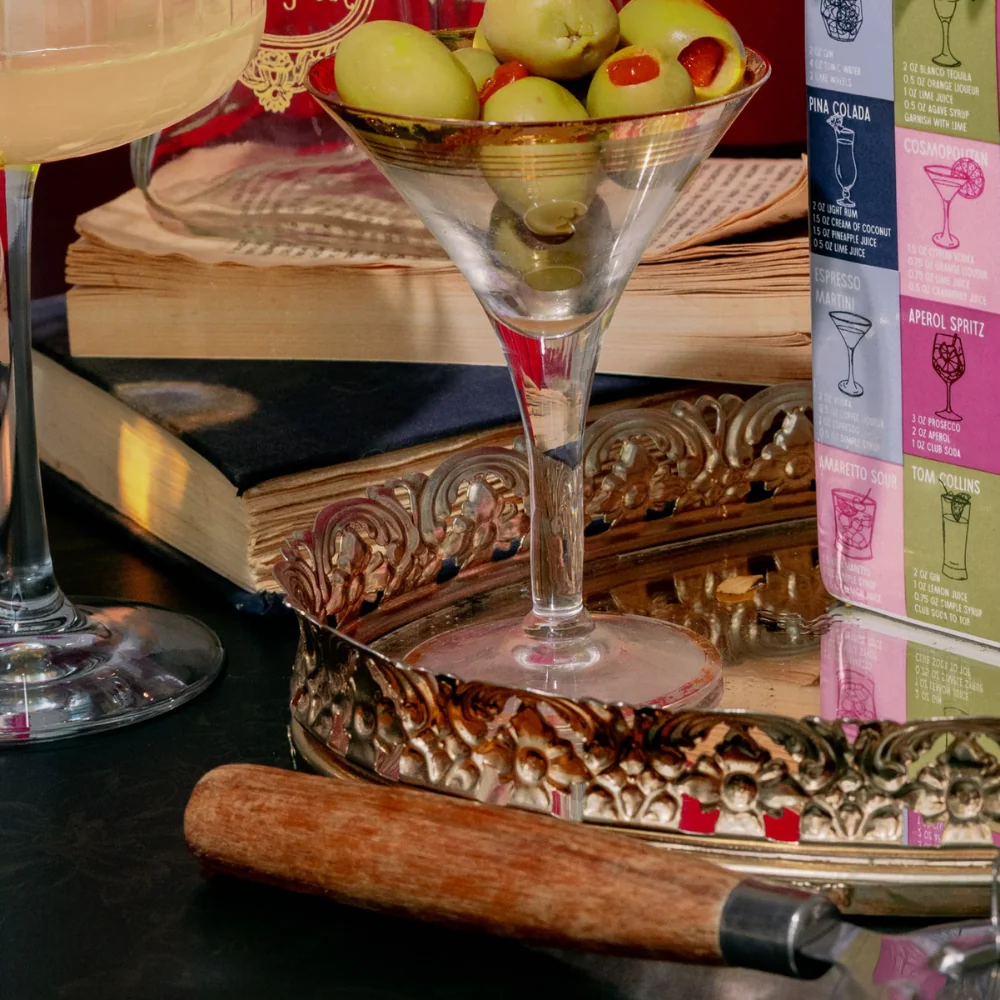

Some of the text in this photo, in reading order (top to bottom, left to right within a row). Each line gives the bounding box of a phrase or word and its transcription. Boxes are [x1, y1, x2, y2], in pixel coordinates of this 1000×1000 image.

[903, 61, 972, 82] 2 OZ BLANCO TEQUILA
[903, 74, 980, 96] 0.5 OZ ORANGE LIQUEUR
[904, 87, 953, 104] 1 OZ LIME JUICE
[809, 96, 871, 122] PINA COLADA
[904, 100, 969, 119] 0.5 OZ AGAVE SYRUP
[904, 112, 967, 133] GARNISH WITH LIME
[904, 138, 988, 167] COSMOPOLITAN
[812, 201, 816, 210] 2
[817, 202, 825, 212] OZ
[844, 207, 858, 219] RUM
[821, 215, 830, 225] OZ
[831, 217, 851, 230] CREAM
[853, 221, 860, 232] OF
[862, 224, 891, 237] COCONUT
[822, 228, 830, 238] OZ
[831, 229, 859, 244] PINEAPPLE
[861, 236, 877, 248] JUICE
[815, 267, 861, 291] ESPRESSO
[815, 288, 855, 311] MARTINI
[908, 307, 985, 338] APEROL SPRITZ
[911, 413, 961, 433] 3 OZ PROSECCO
[912, 426, 951, 444] 2 OZ APEROL
[912, 439, 962, 459] 1 OZ CLUB SODA
[818, 455, 897, 490] AMARETTO SOUR
[911, 465, 981, 495] TOM COLLINS
